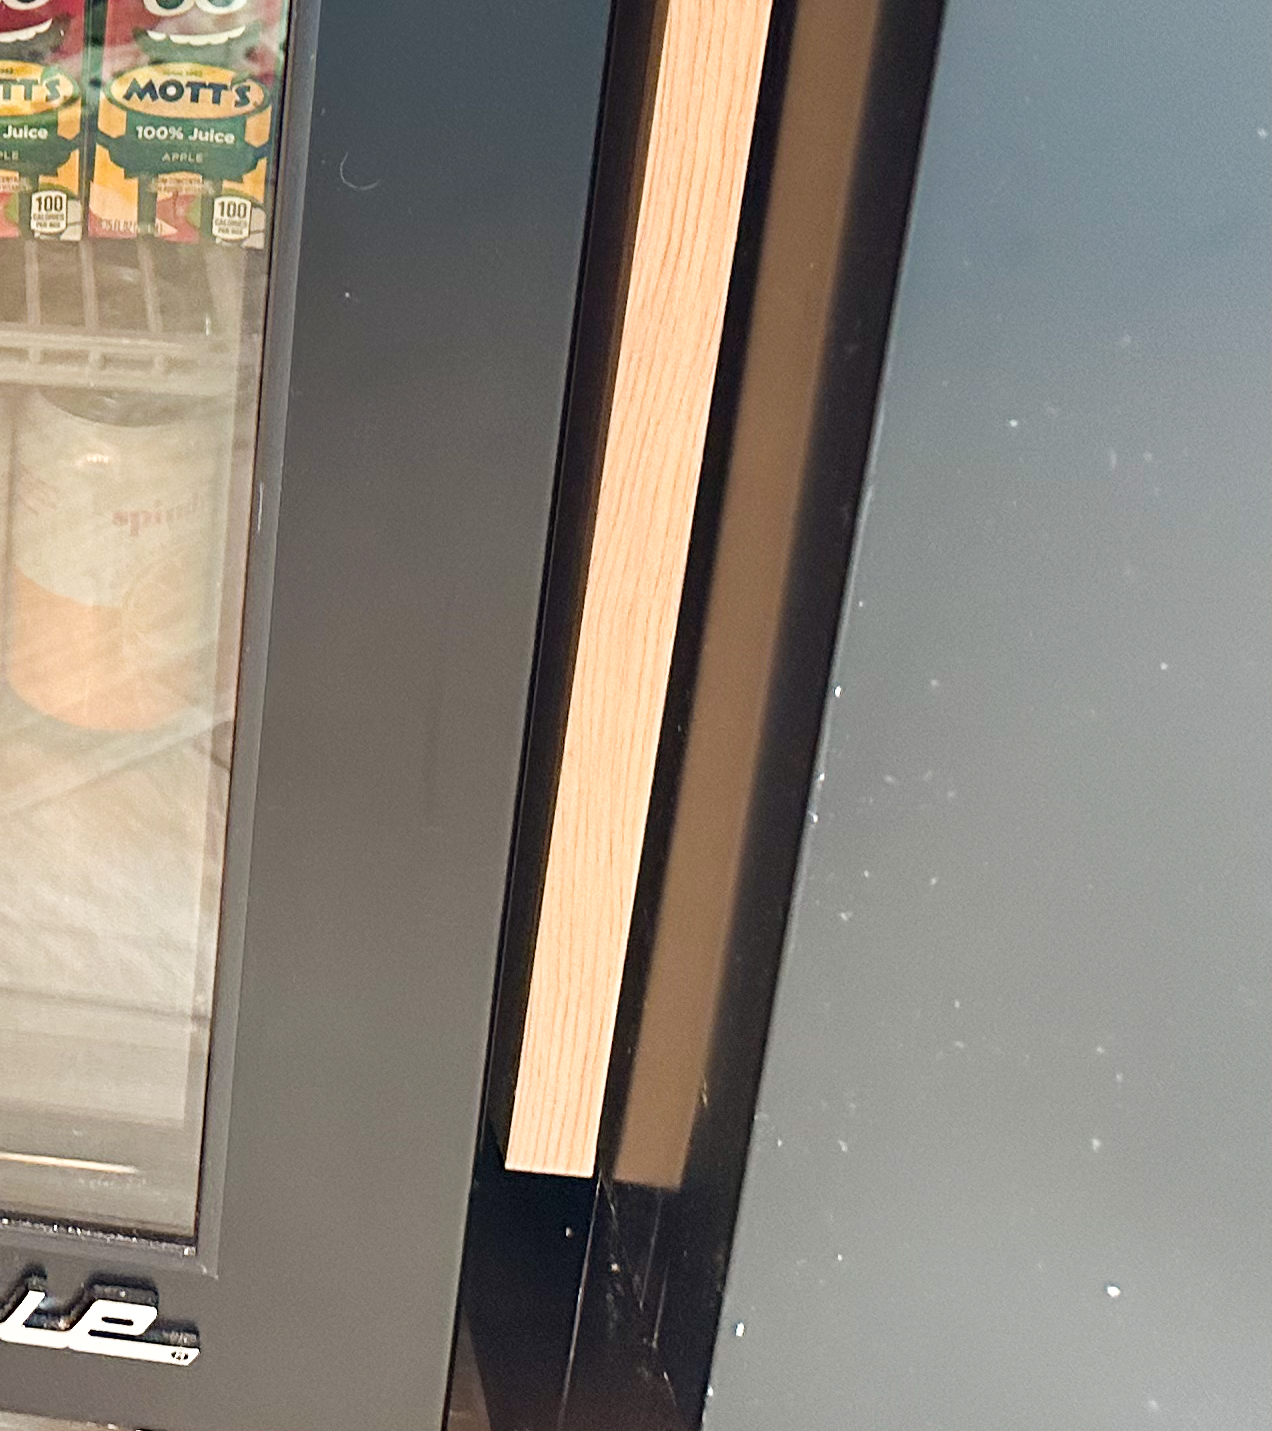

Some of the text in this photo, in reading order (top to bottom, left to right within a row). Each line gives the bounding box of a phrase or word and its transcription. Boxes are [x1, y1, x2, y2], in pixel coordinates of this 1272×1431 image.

[123, 77, 251, 108] MOTT'S
[3, 124, 48, 140] Juice
[136, 125, 235, 145] 100% Juice
[161, 152, 203, 163] APPLE
[35, 195, 63, 212] 100
[218, 200, 247, 219] 100
